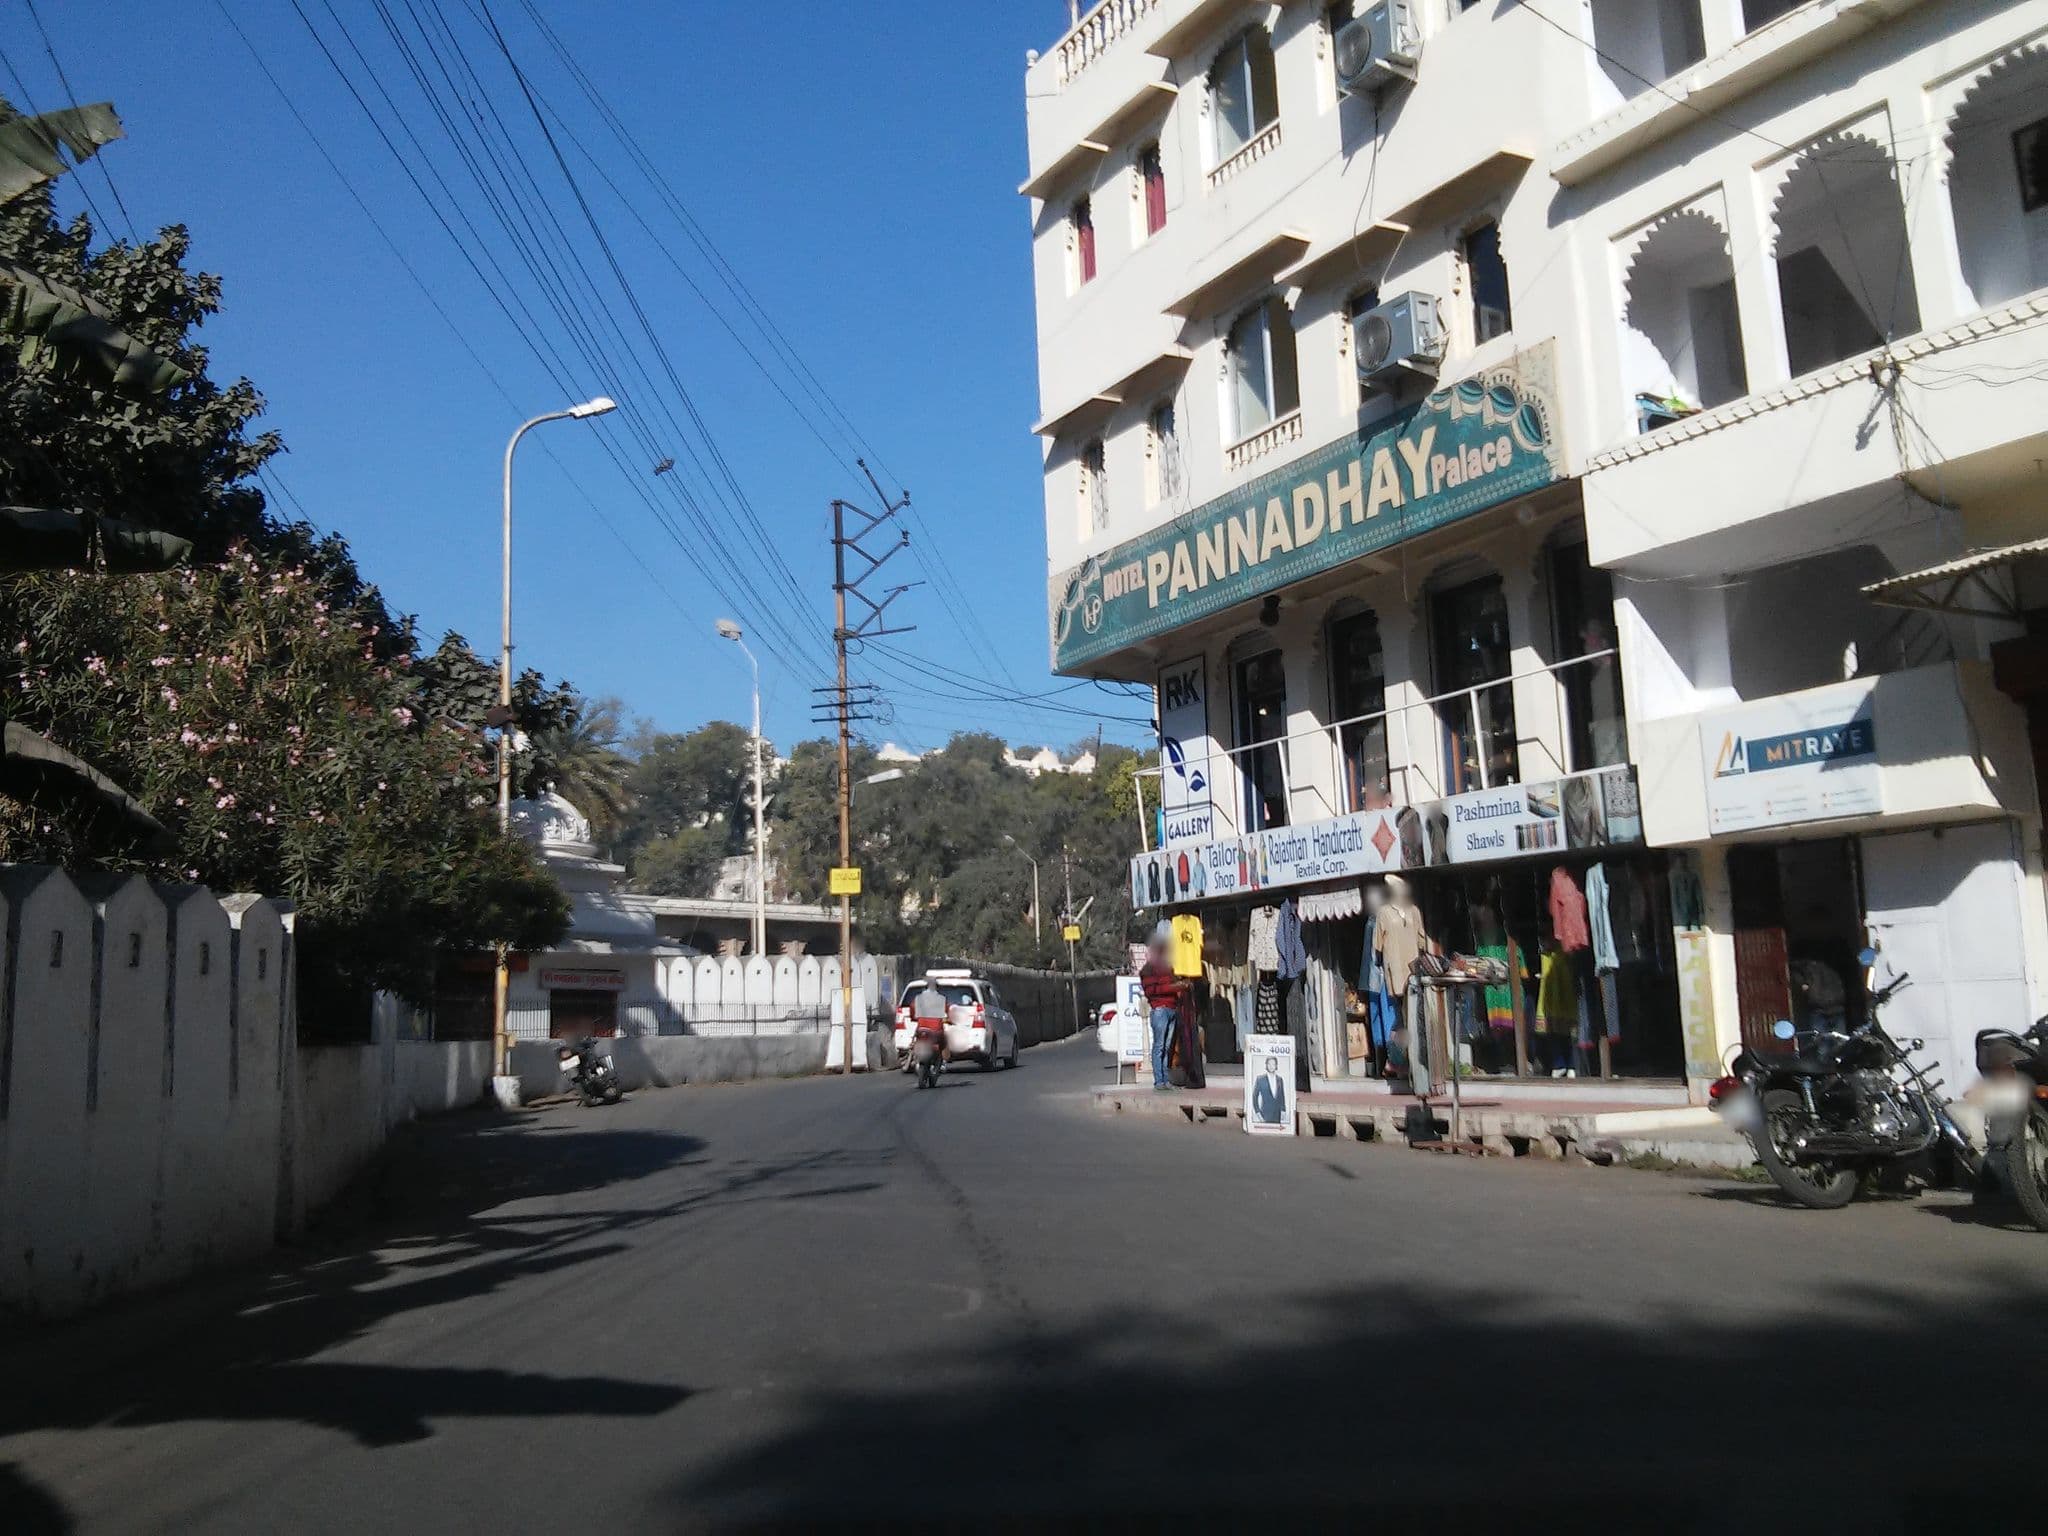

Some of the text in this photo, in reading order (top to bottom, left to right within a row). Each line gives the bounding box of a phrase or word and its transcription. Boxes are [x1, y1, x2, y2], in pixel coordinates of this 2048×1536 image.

[1103, 425, 1513, 608] HOTEL PANNADHAY Palace
[1165, 669, 1200, 711] RK
[1455, 797, 1522, 823] Pashmina
[1168, 817, 1210, 840] GALLERY
[1466, 830, 1505, 851] Shawls
[1206, 841, 1238, 869] Tailor
[1268, 818, 1363, 872] Rajasthan Handicrafts
[1294, 858, 1348, 878] Textile Corp.
[1214, 870, 1235, 891] Shop
[1269, 1045, 1291, 1054] 4000
